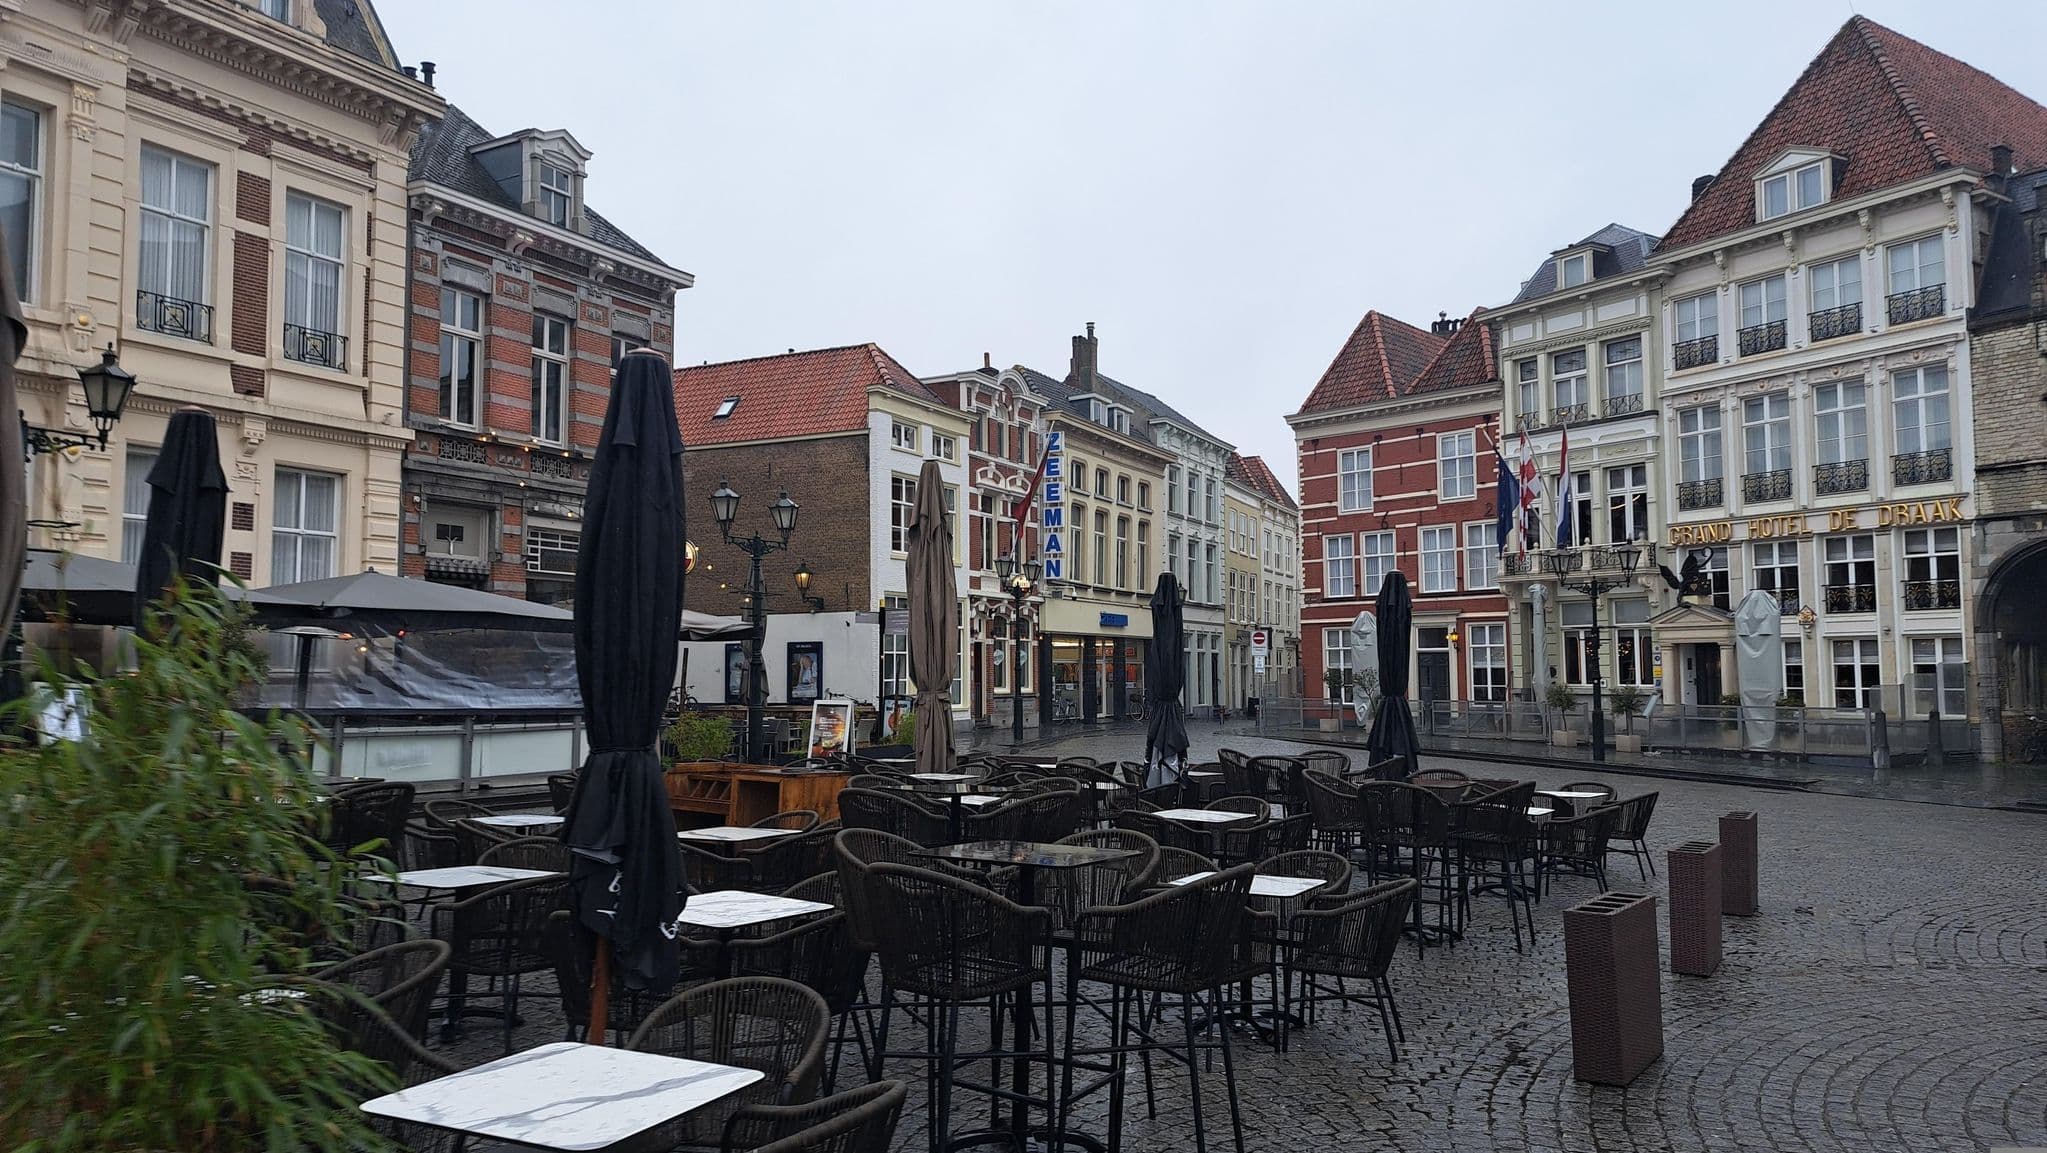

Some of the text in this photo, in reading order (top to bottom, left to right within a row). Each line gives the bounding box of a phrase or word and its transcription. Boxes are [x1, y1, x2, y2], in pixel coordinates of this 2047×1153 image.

[1044, 433, 1061, 577] ZEEMAN
[1669, 498, 1964, 545] GRAND HOTEL DE DRAAK
